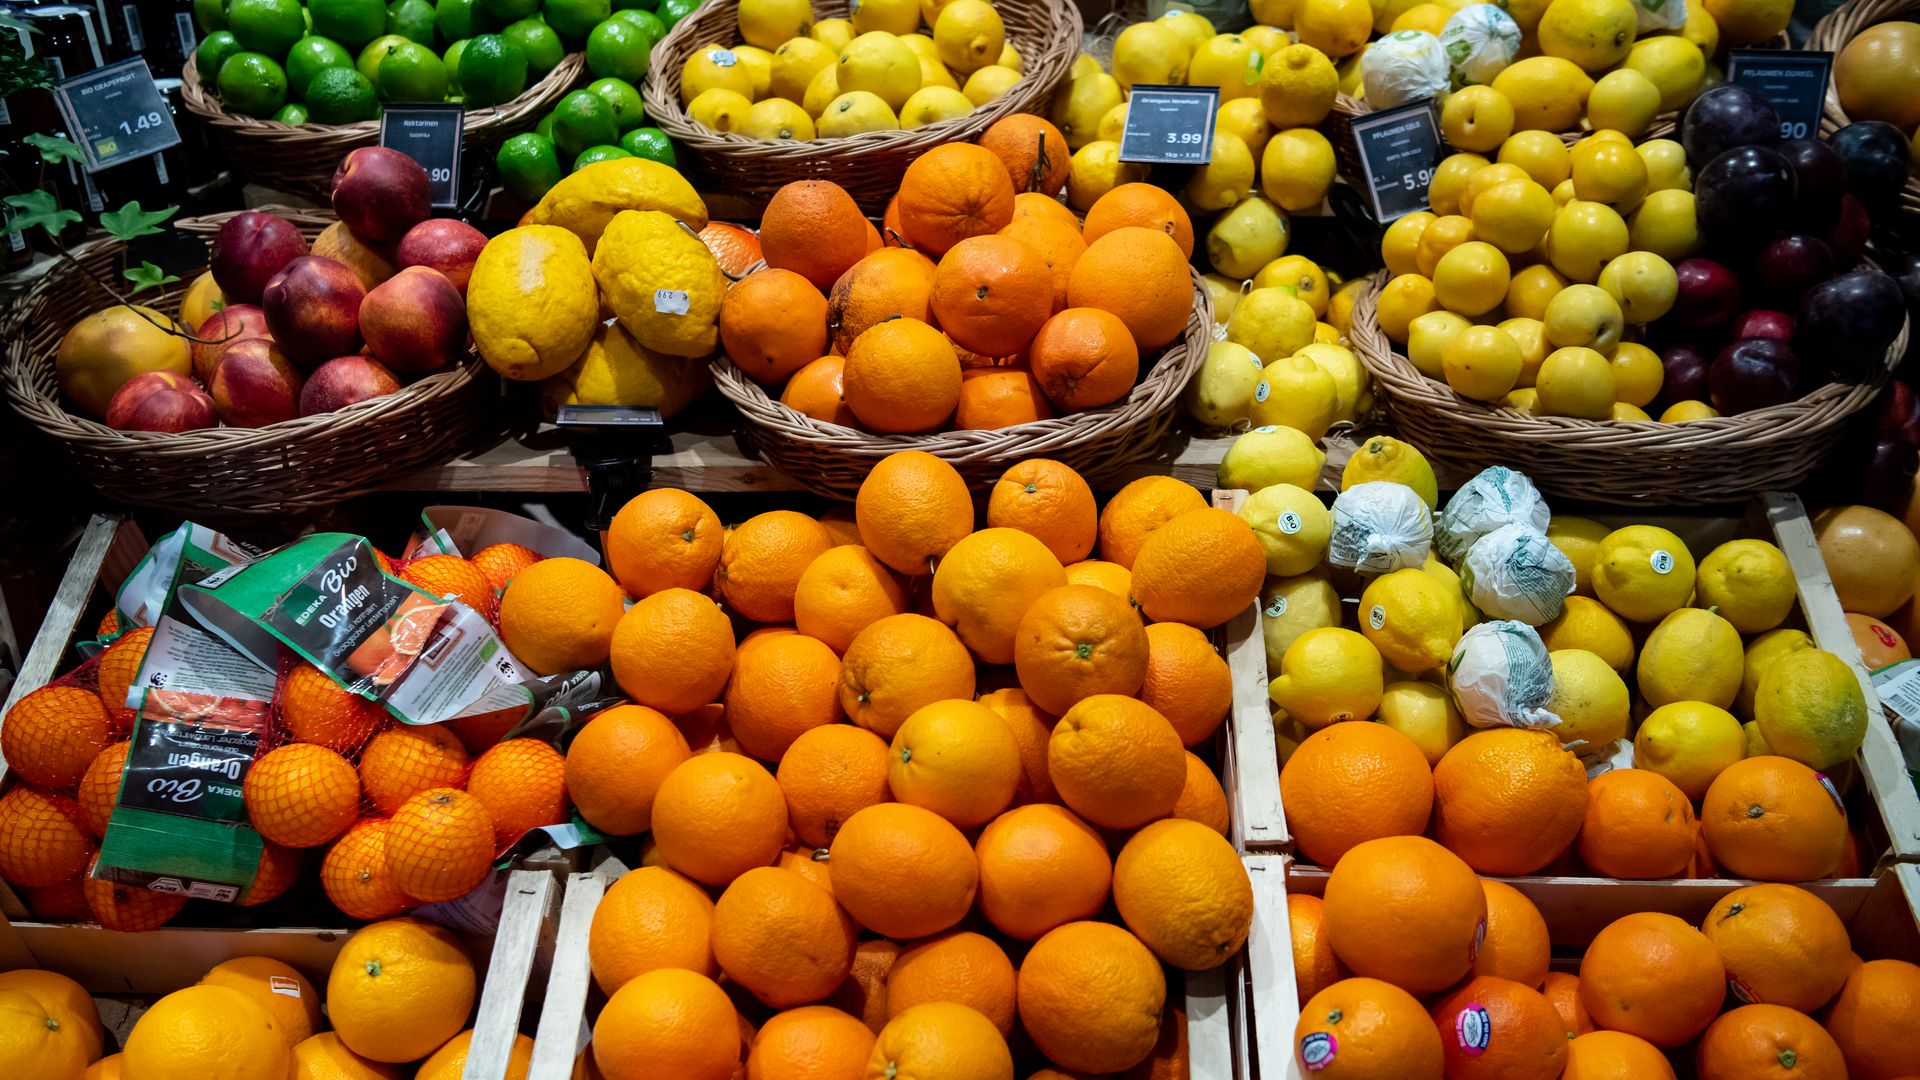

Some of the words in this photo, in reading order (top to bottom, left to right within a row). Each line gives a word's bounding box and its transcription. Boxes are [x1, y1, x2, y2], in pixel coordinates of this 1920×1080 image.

[81, 88, 93, 96] BIO
[94, 72, 136, 91] GRAPEFRUIT
[119, 111, 162, 135] 1.49
[403, 119, 439, 127] Nektarinen
[1166, 132, 1202, 144] 3.99
[97, 142, 117, 155] BIO
[1286, 515, 1297, 529] BIO
[1659, 555, 1668, 570] BIO
[295, 594, 328, 625] EDEKA
[320, 556, 357, 594] Bio
[319, 584, 371, 629] Orangen
[168, 752, 241, 781] Orangen
[146, 778, 205, 803] Bio
[208, 784, 244, 798] DEKA
